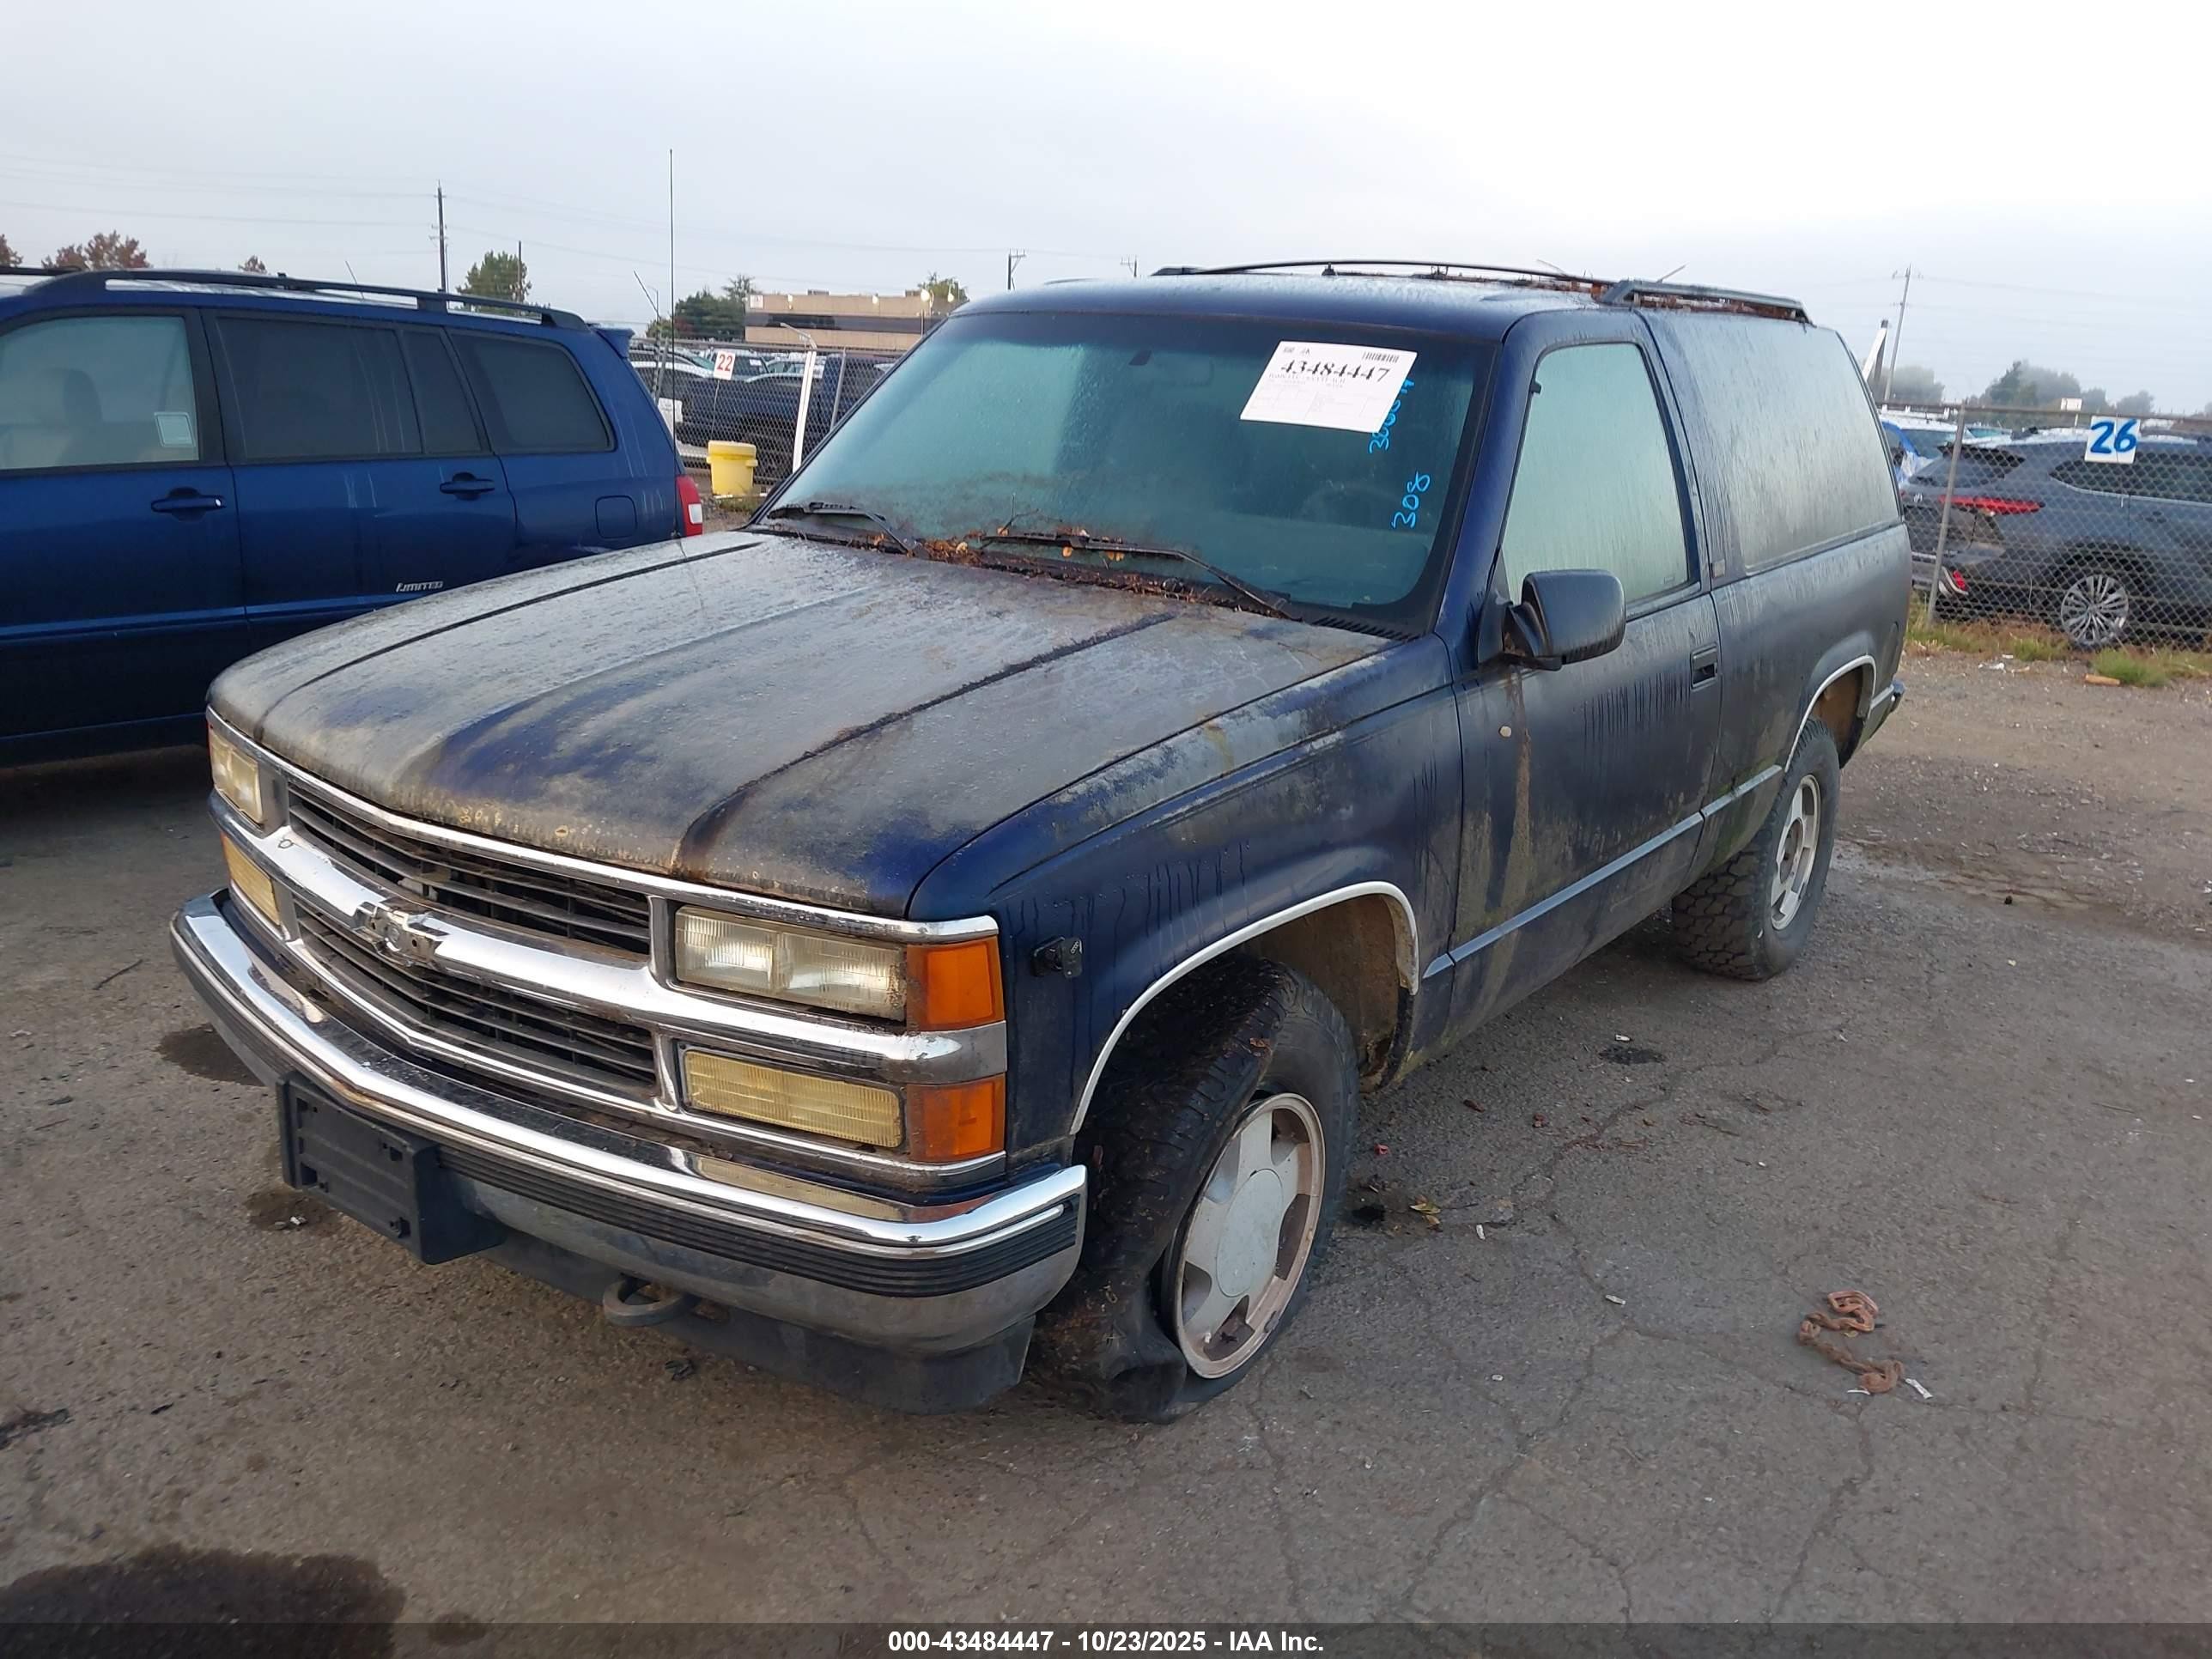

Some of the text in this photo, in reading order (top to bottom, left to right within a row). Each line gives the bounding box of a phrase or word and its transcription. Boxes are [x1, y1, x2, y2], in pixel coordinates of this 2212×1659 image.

[716, 354, 733, 371] 22
[1281, 359, 1391, 382] 43484447
[2089, 418, 2138, 454] 26
[1391, 471, 1431, 529] 308
